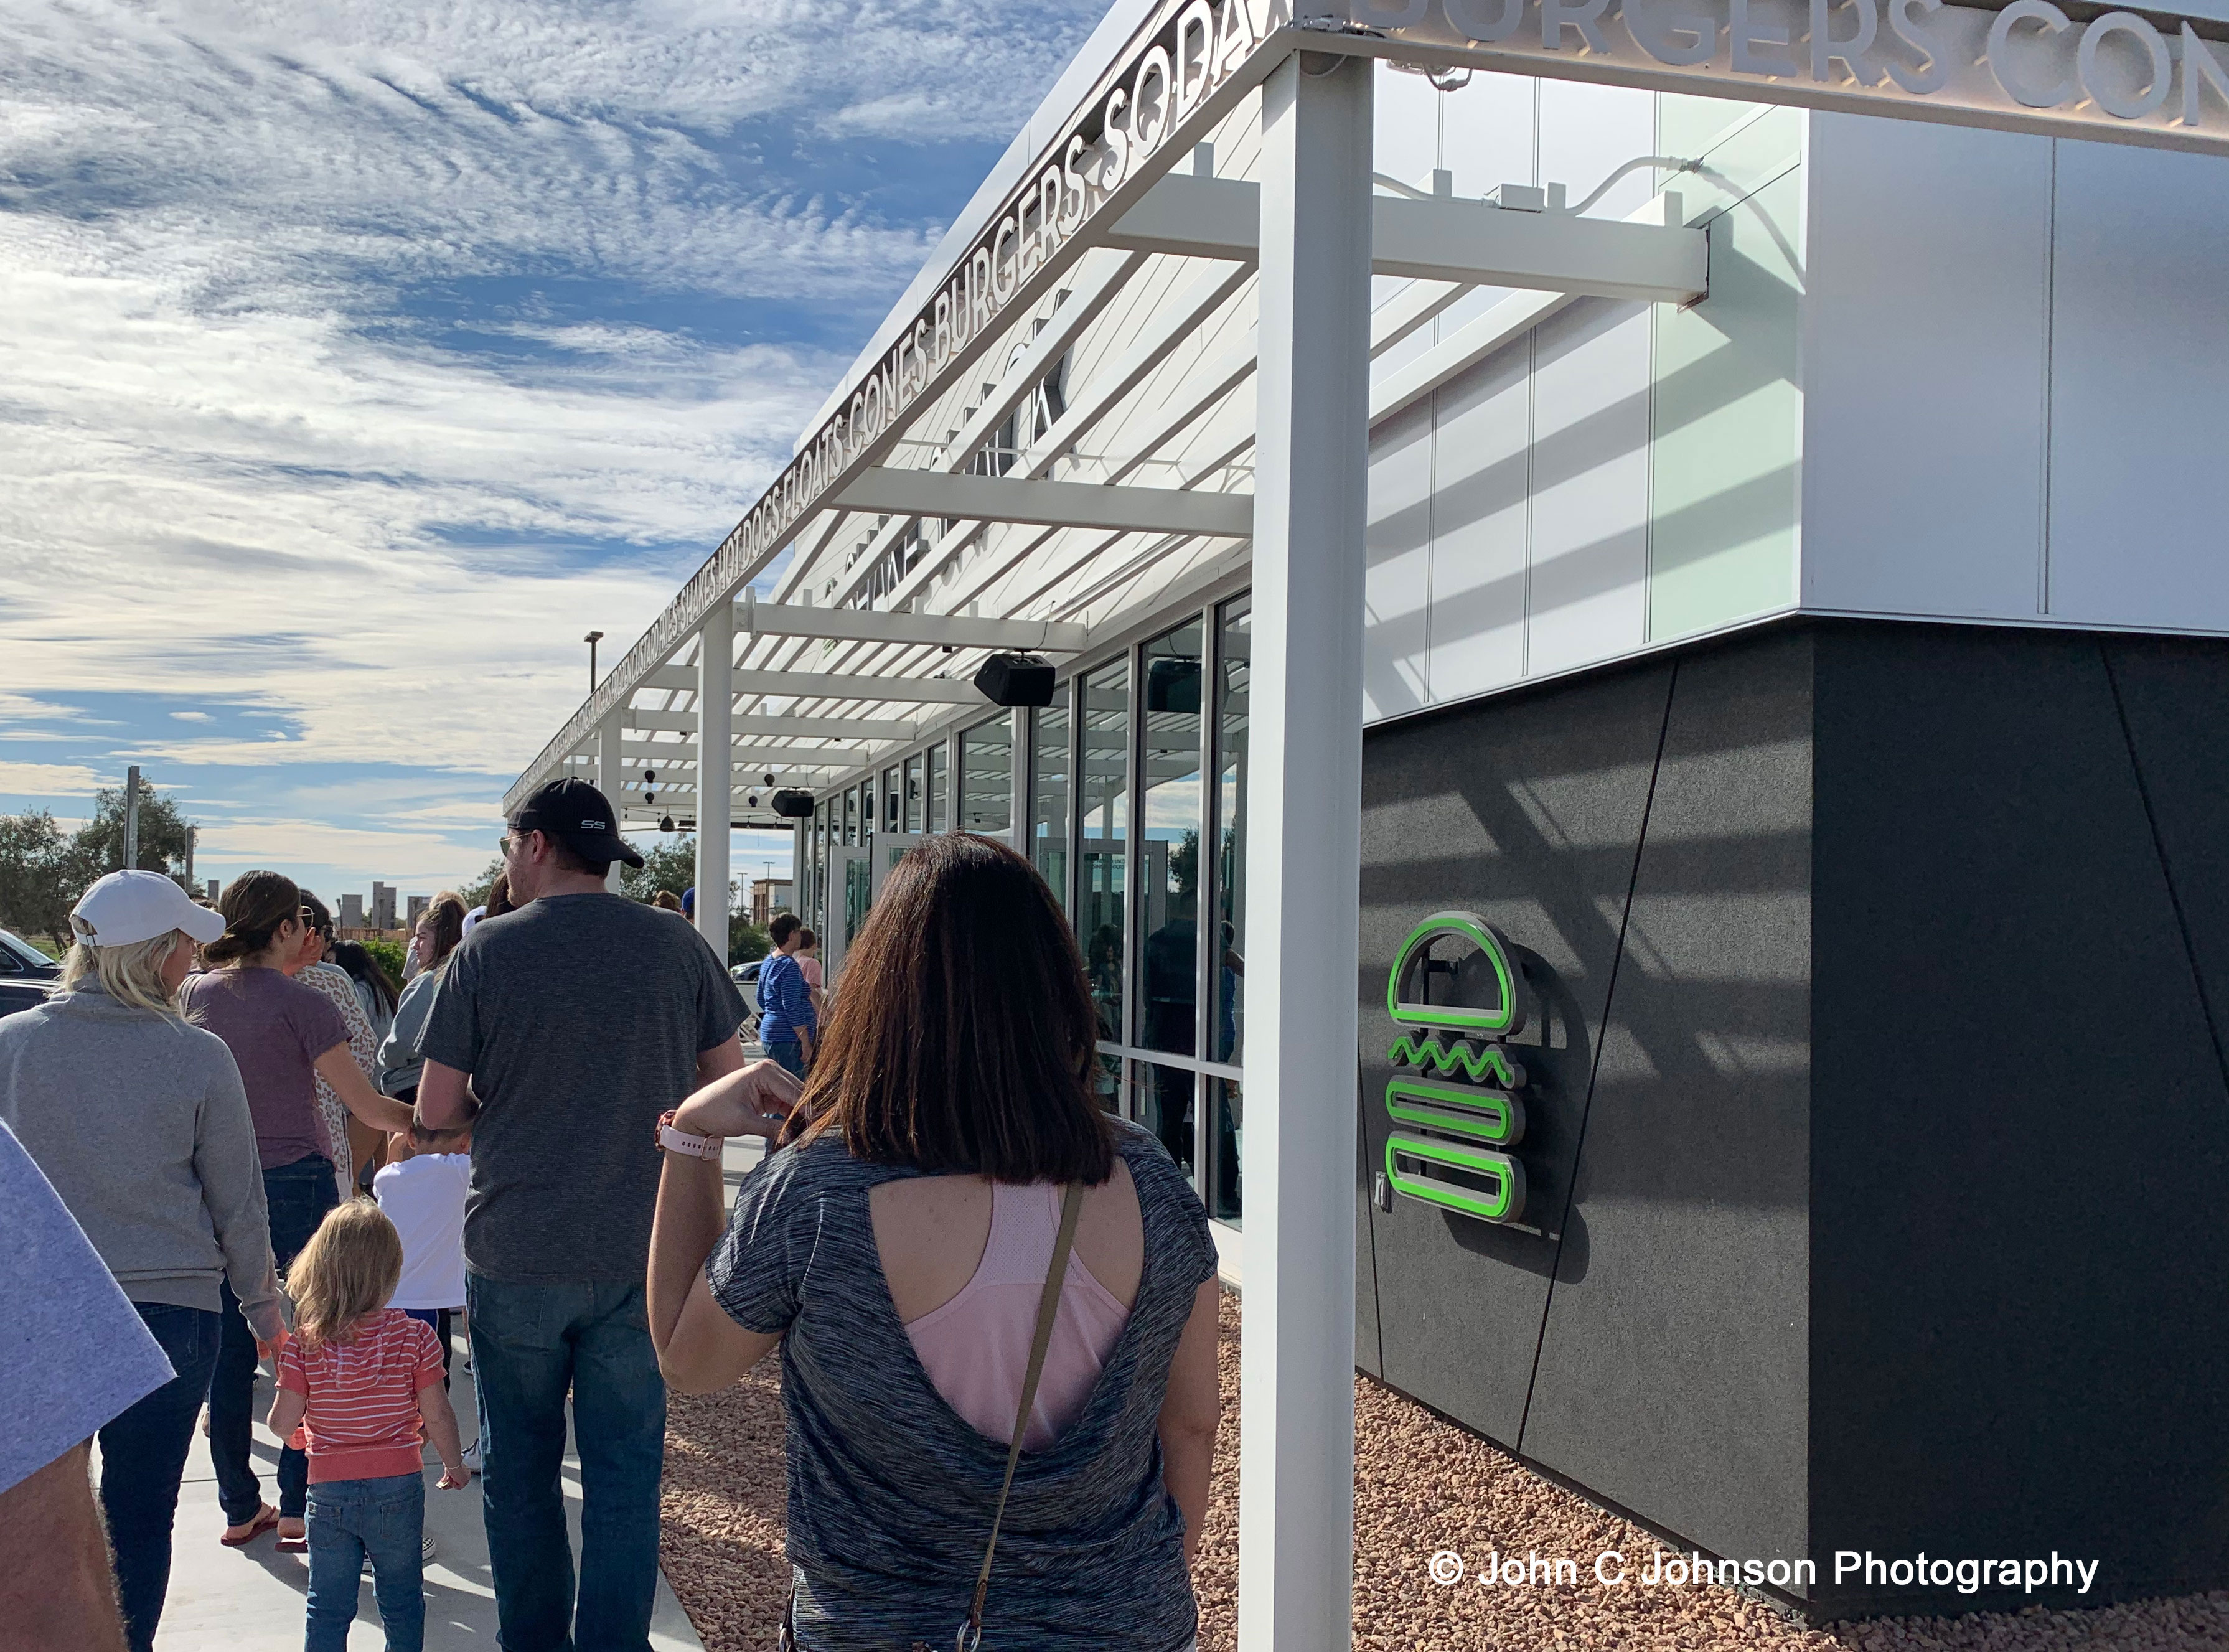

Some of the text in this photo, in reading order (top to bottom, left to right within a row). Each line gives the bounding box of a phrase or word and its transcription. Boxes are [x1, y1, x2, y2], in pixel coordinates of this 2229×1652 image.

[1349, 0, 1949, 94] RGERS
[632, 622, 659, 680] CUSTARD
[680, 556, 716, 630] SHAKES
[718, 526, 742, 594] HOT
[743, 485, 780, 570] DOGS
[783, 414, 845, 528] FLOATS
[848, 317, 929, 459] CONES
[934, 134, 1087, 373] BURGERS
[580, 820, 606, 830] SS
